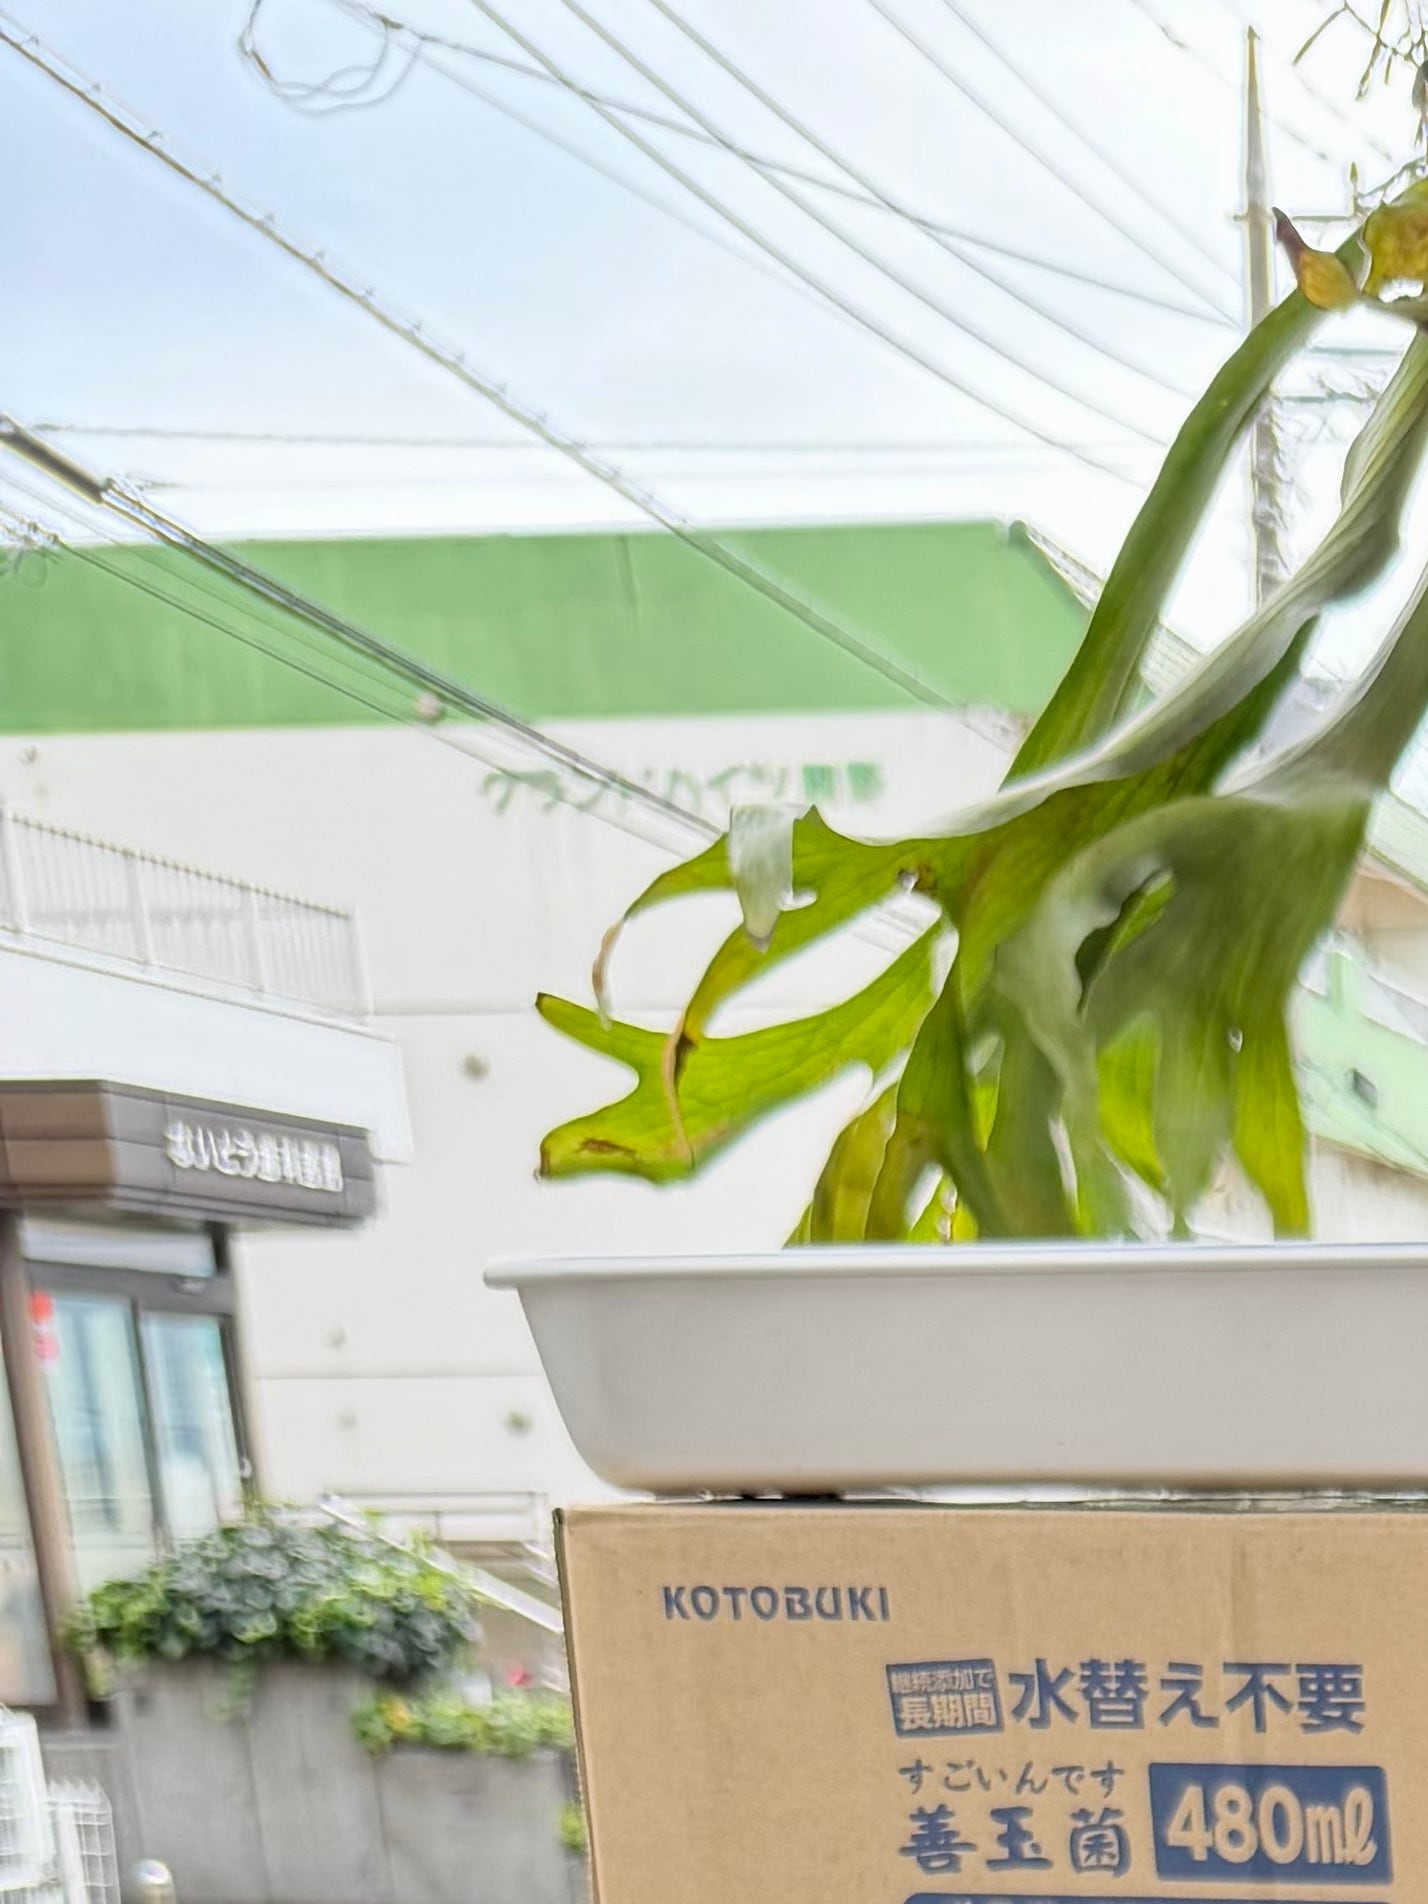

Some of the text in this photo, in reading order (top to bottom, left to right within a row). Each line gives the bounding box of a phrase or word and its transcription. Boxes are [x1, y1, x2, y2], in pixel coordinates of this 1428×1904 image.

[663, 1585, 890, 1622] KOTOBUKI
[891, 1668, 992, 1694] 継続添加で
[1008, 1657, 1366, 1735] 水替え不要
[899, 1693, 997, 1730] 長期間
[898, 1759, 1125, 1797] すごいんです
[899, 1803, 1132, 1878] 善玉菌
